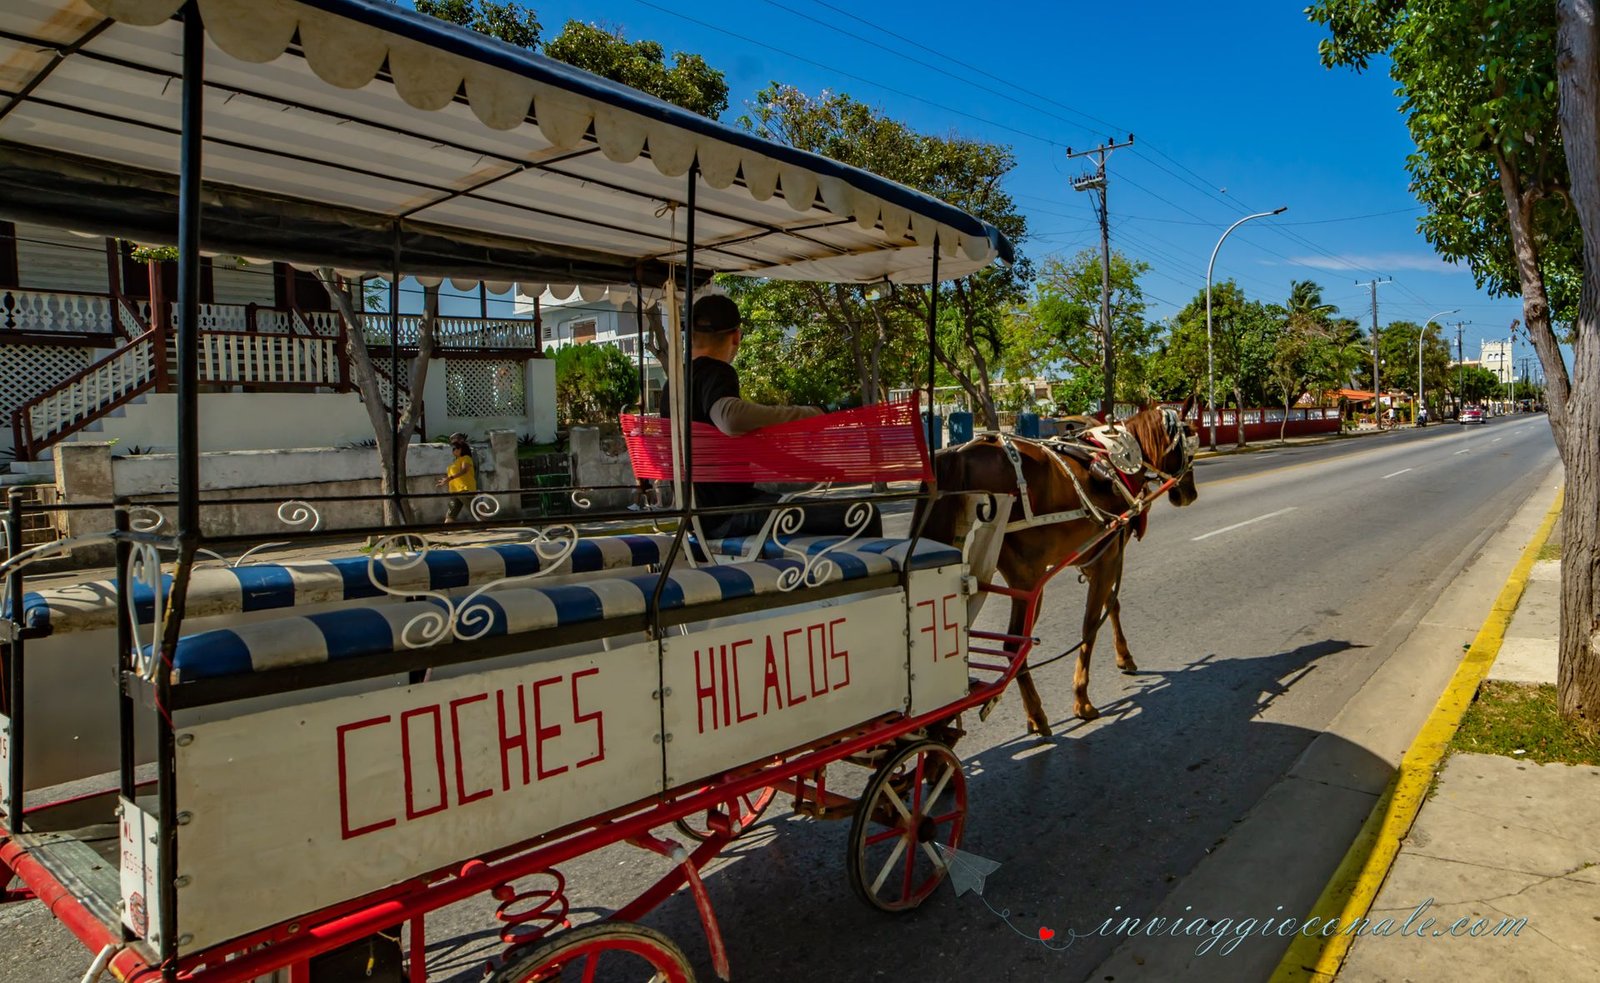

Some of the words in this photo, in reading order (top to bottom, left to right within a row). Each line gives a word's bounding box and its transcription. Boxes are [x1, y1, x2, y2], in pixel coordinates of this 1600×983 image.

[916, 593, 959, 663] 75
[336, 667, 605, 840] COCHES
[694, 617, 850, 734] HICACOS
